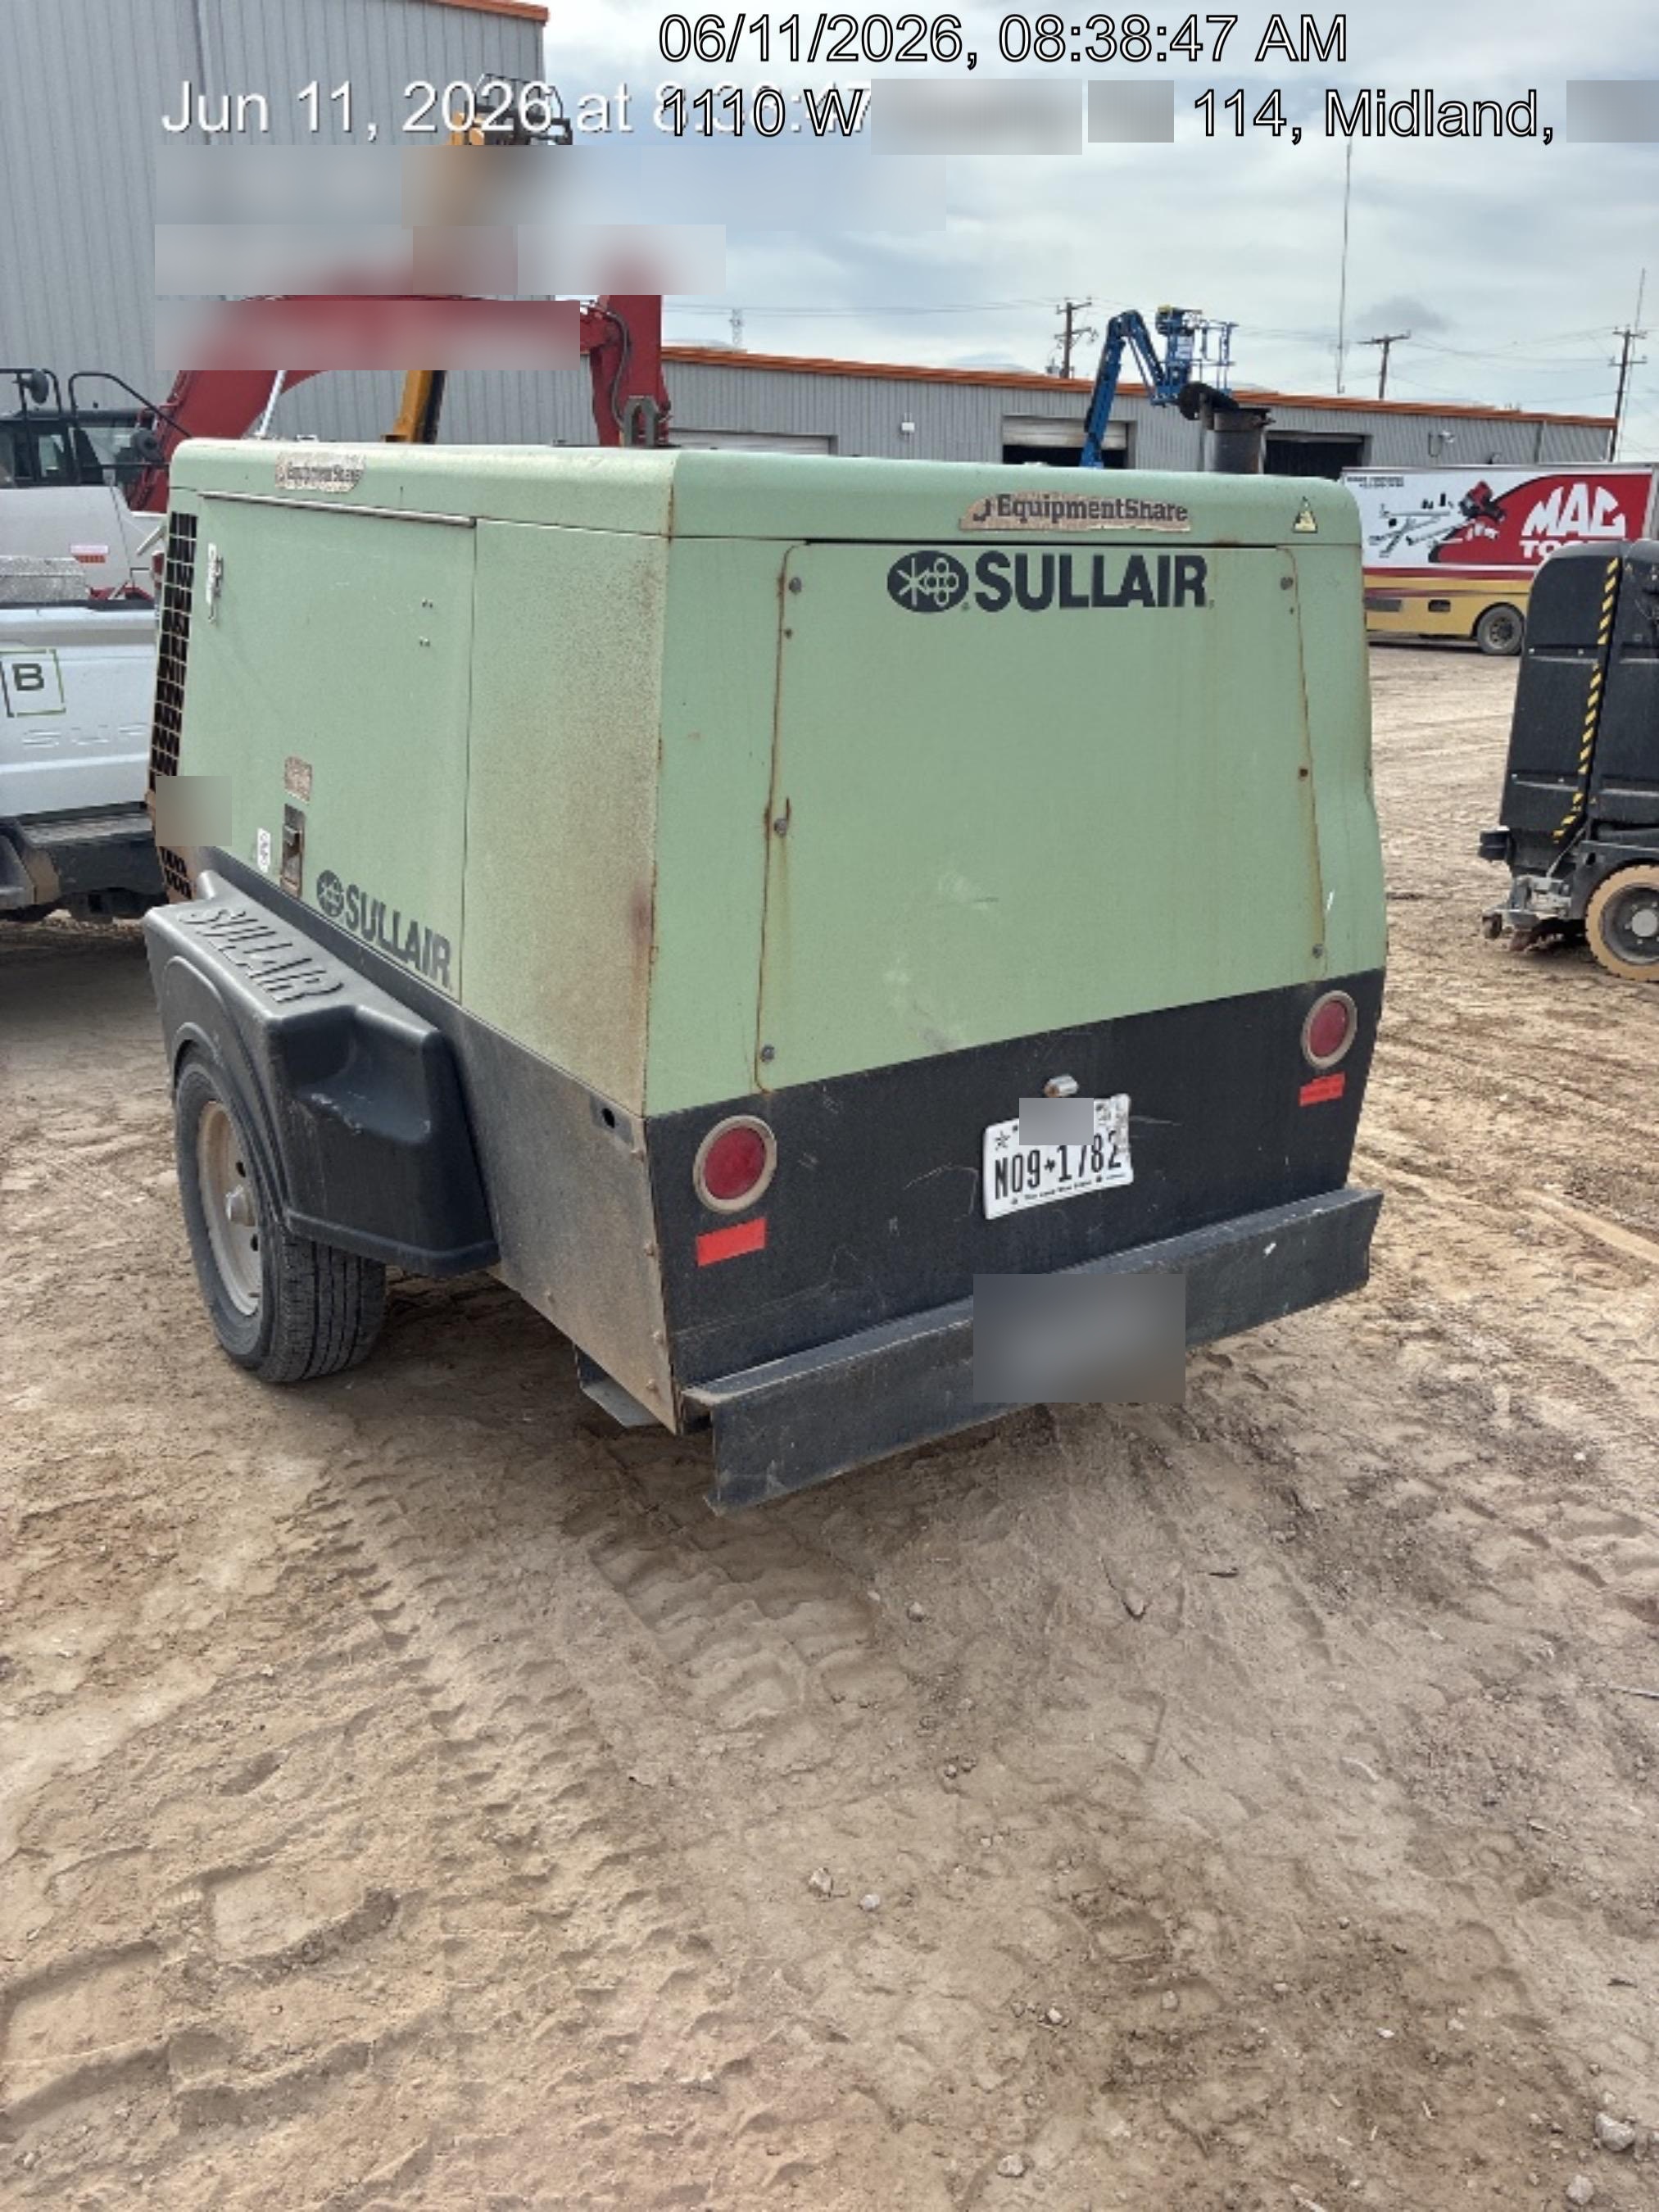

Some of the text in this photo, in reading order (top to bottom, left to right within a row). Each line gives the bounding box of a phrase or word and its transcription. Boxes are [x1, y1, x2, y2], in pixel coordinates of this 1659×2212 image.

[997, 493, 1188, 524] EquipmentShare
[975, 550, 1208, 612] SULLAIR
[12, 664, 44, 691] B
[343, 883, 451, 987] SULLAIR
